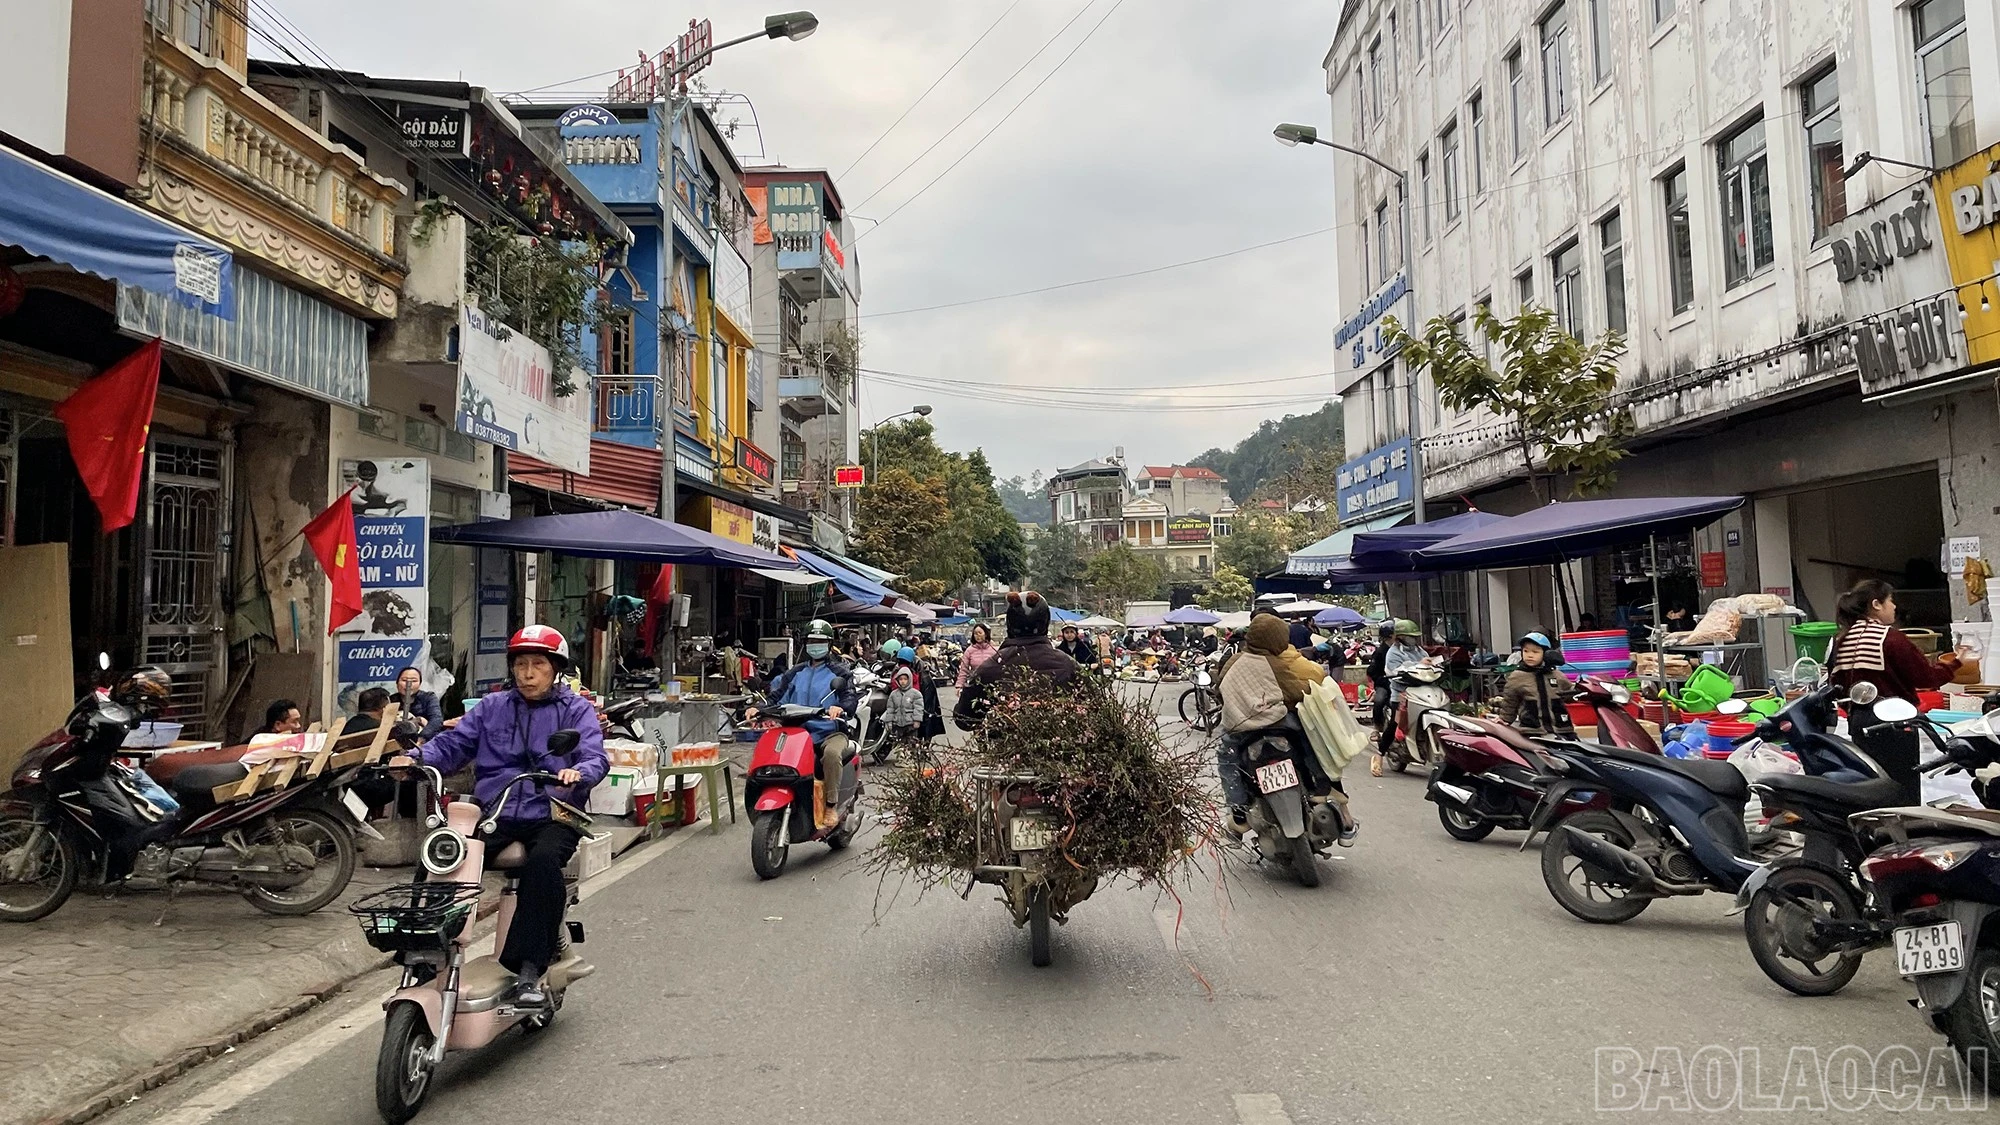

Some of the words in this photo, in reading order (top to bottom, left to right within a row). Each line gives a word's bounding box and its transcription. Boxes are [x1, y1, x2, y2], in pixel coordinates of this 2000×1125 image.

[402, 117, 427, 139] GỘI
[428, 114, 459, 135] ĐẦU
[561, 107, 609, 126] SONHA
[440, 140, 456, 149] 382
[774, 182, 817, 206] NHÀ
[771, 205, 821, 232] NGHỈ
[1830, 219, 1895, 283] ĐẠI
[1888, 186, 1933, 258] LÝ
[474, 421, 511, 447] 0387788382
[360, 522, 406, 536] CHUYÊN
[381, 538, 416, 559] ĐẦU
[359, 566, 381, 583] AM
[395, 562, 419, 582] NỮ
[348, 645, 385, 660] CHĂM
[386, 644, 413, 659] SÓC
[368, 663, 394, 677] TÓC
[1905, 925, 1949, 951] 24-B1
[1901, 946, 1959, 972] 478.99
